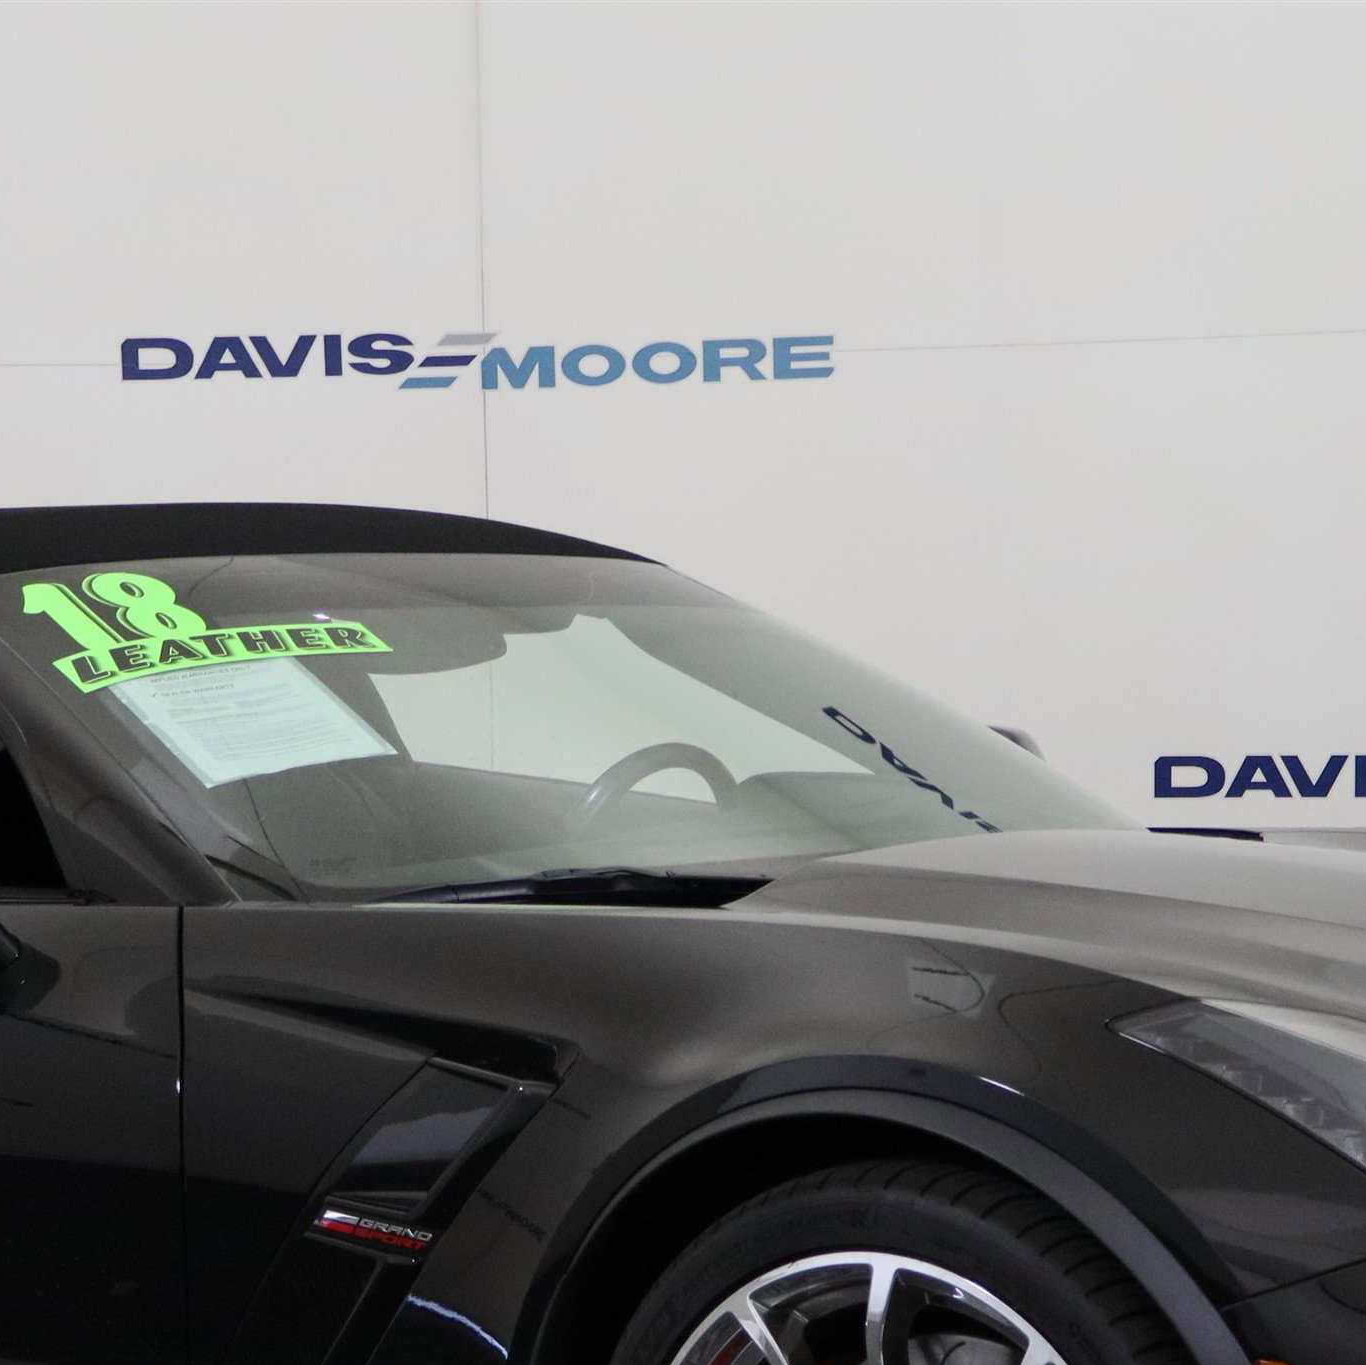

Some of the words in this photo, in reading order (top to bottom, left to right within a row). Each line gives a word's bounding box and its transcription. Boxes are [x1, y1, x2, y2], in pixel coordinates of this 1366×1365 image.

[120, 332, 414, 381] DAVIS
[480, 334, 834, 391] MOORE
[22, 572, 207, 650] 18
[71, 626, 373, 685] LEATHER
[354, 1229, 427, 1250] SPORT
[358, 1218, 433, 1241] GRAND
